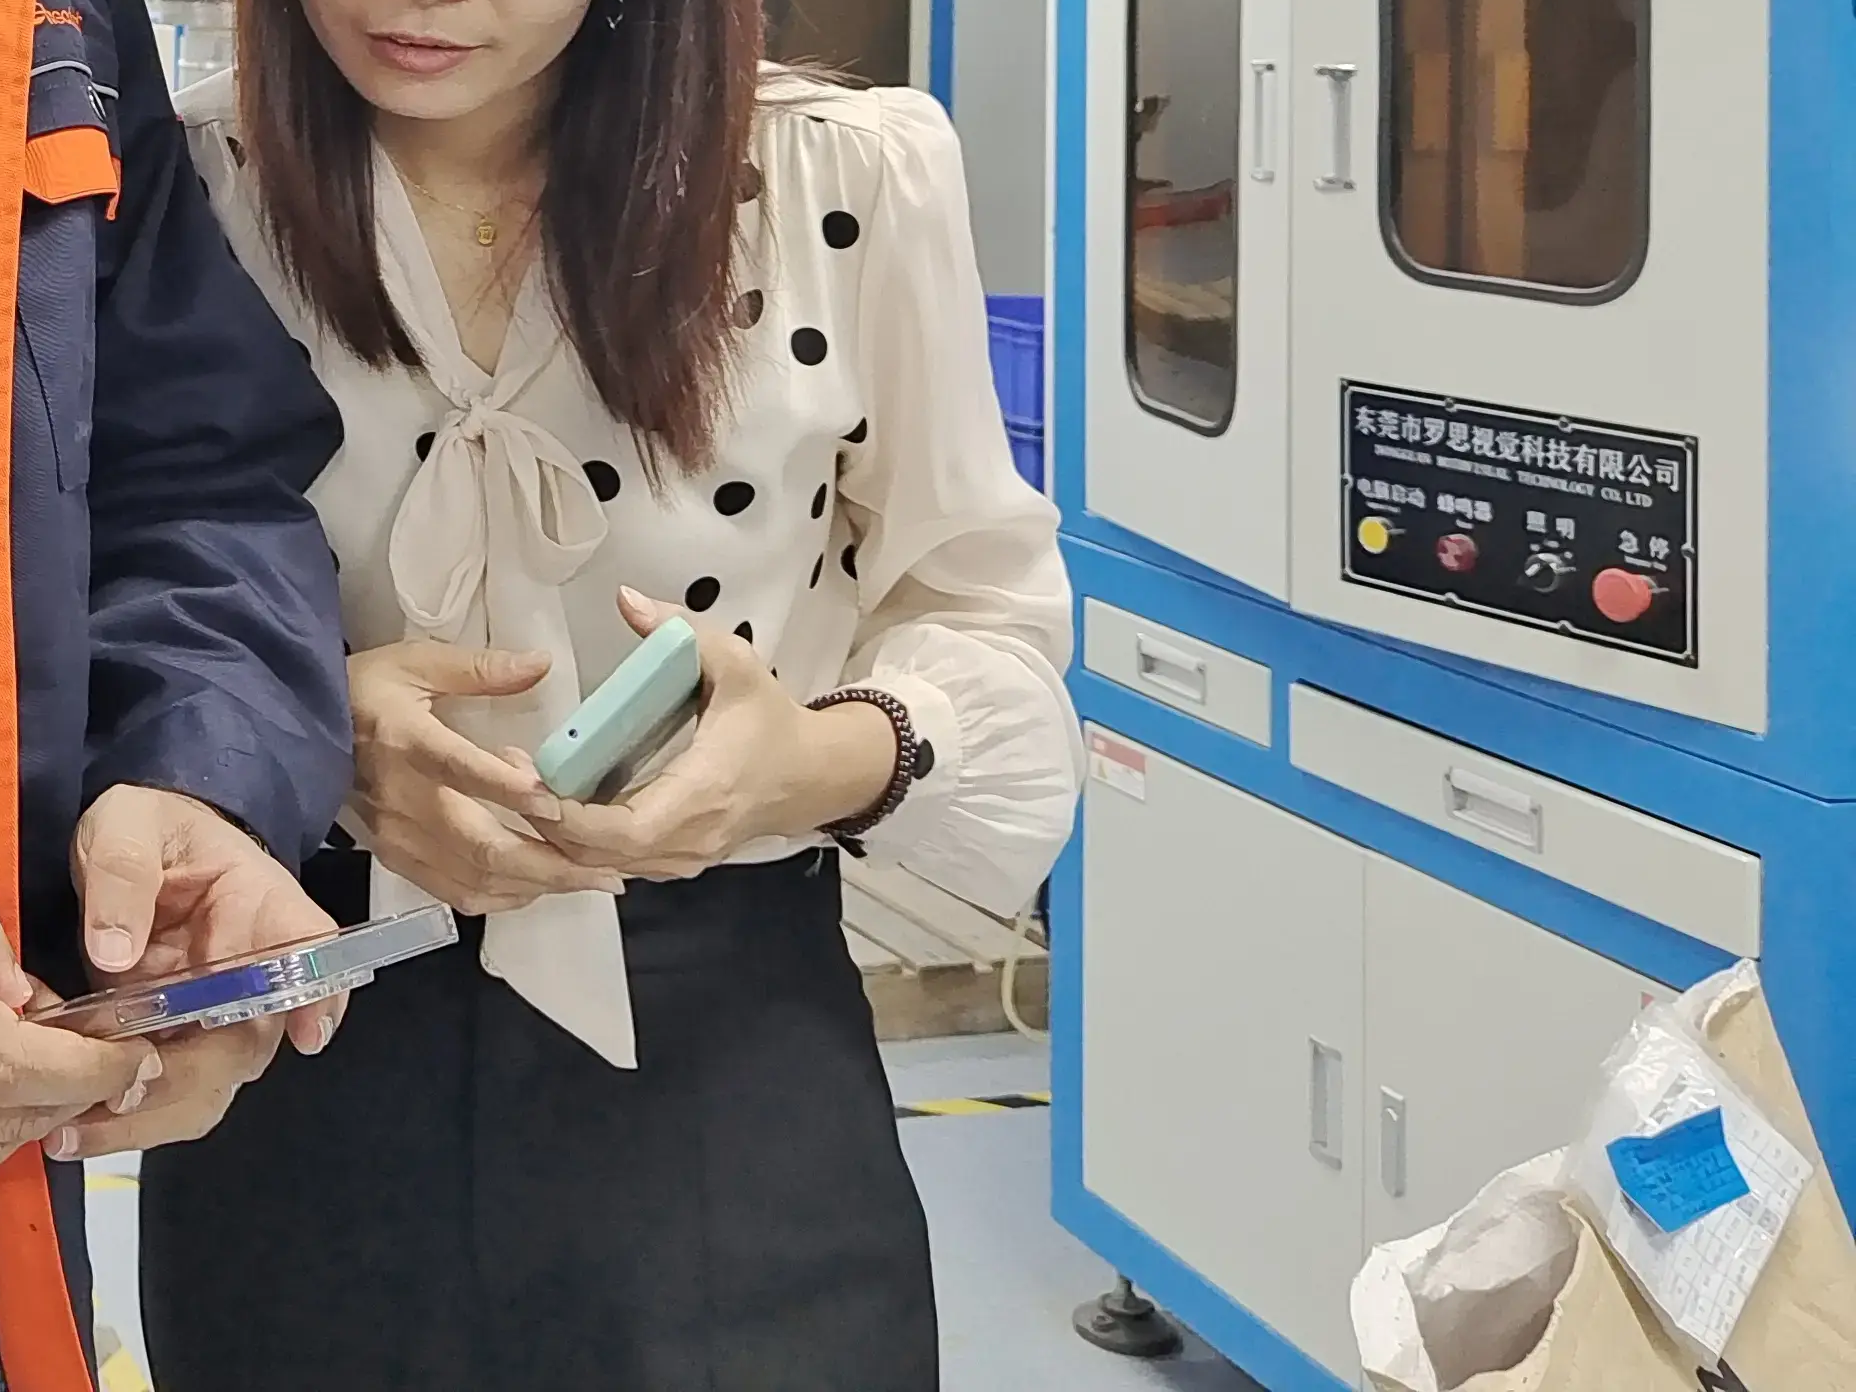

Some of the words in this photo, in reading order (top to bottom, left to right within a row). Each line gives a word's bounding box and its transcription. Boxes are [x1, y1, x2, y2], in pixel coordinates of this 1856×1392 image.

[1355, 405, 1680, 492] 东莞市罗思视觉科技有限公司
